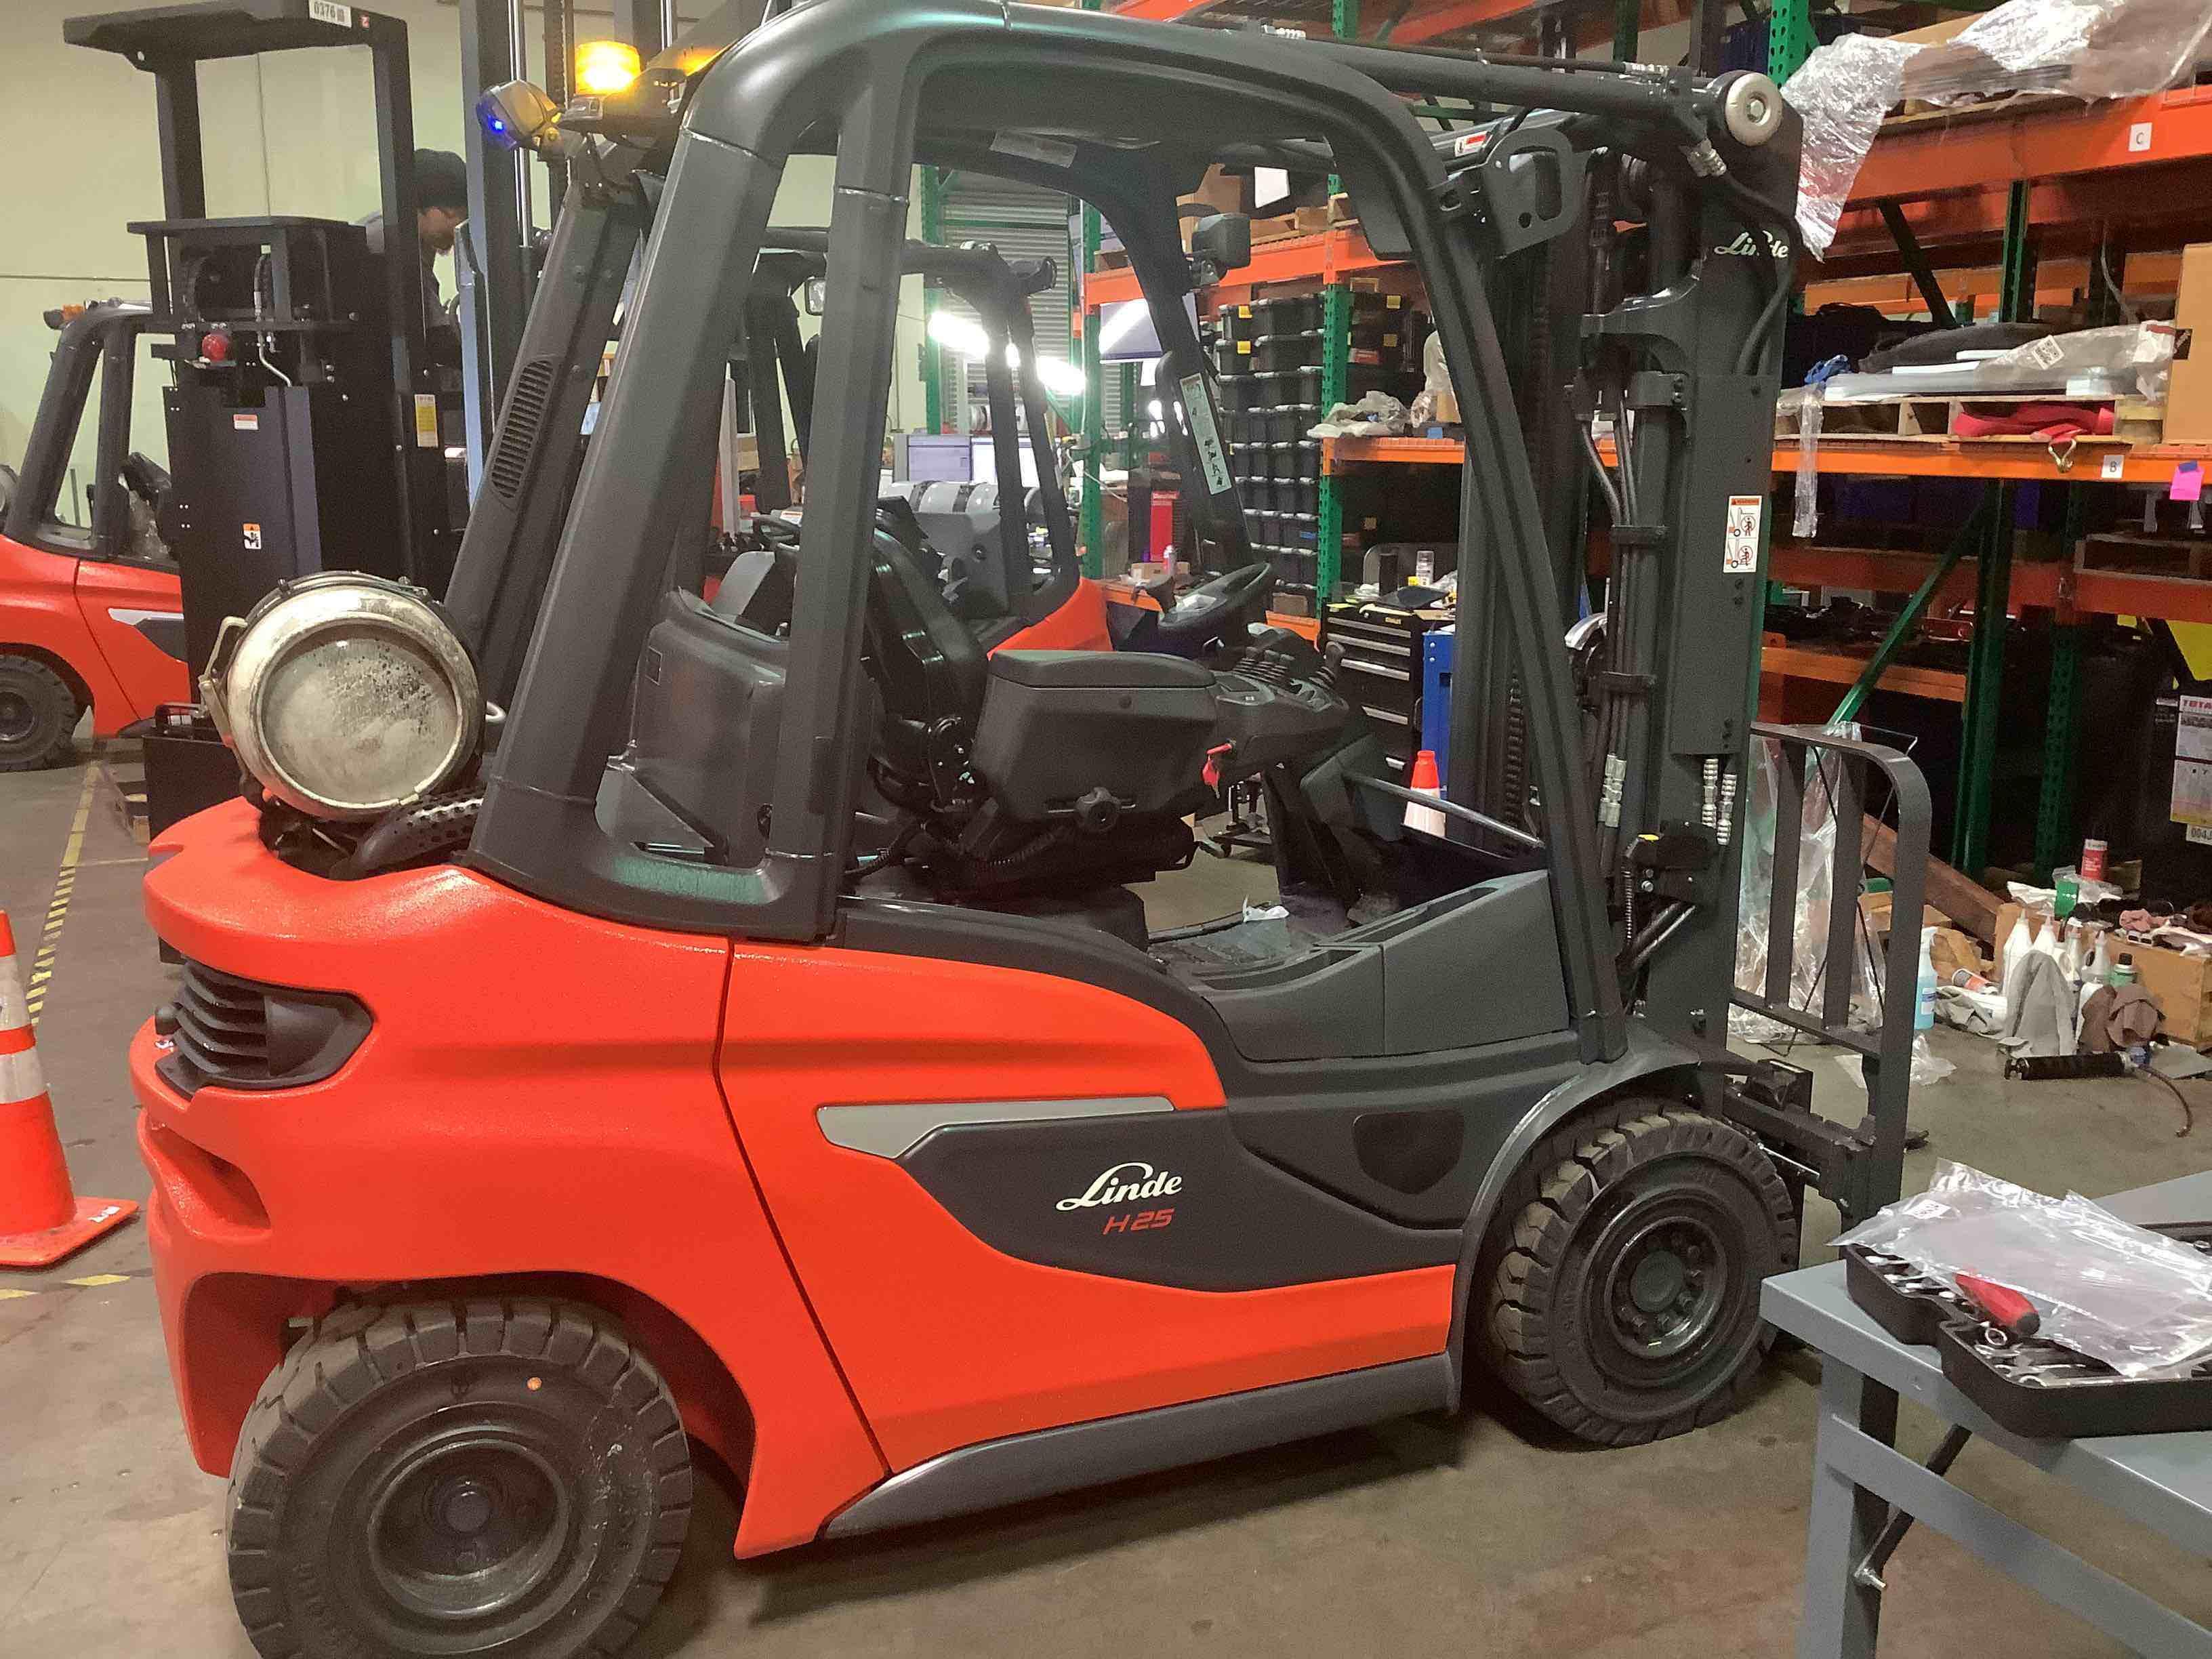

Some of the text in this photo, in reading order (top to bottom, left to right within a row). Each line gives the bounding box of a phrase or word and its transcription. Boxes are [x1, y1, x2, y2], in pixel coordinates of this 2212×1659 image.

[2135, 131, 2146, 144] C
[2109, 461, 2117, 472] B
[1055, 1162, 1183, 1211] Linde
